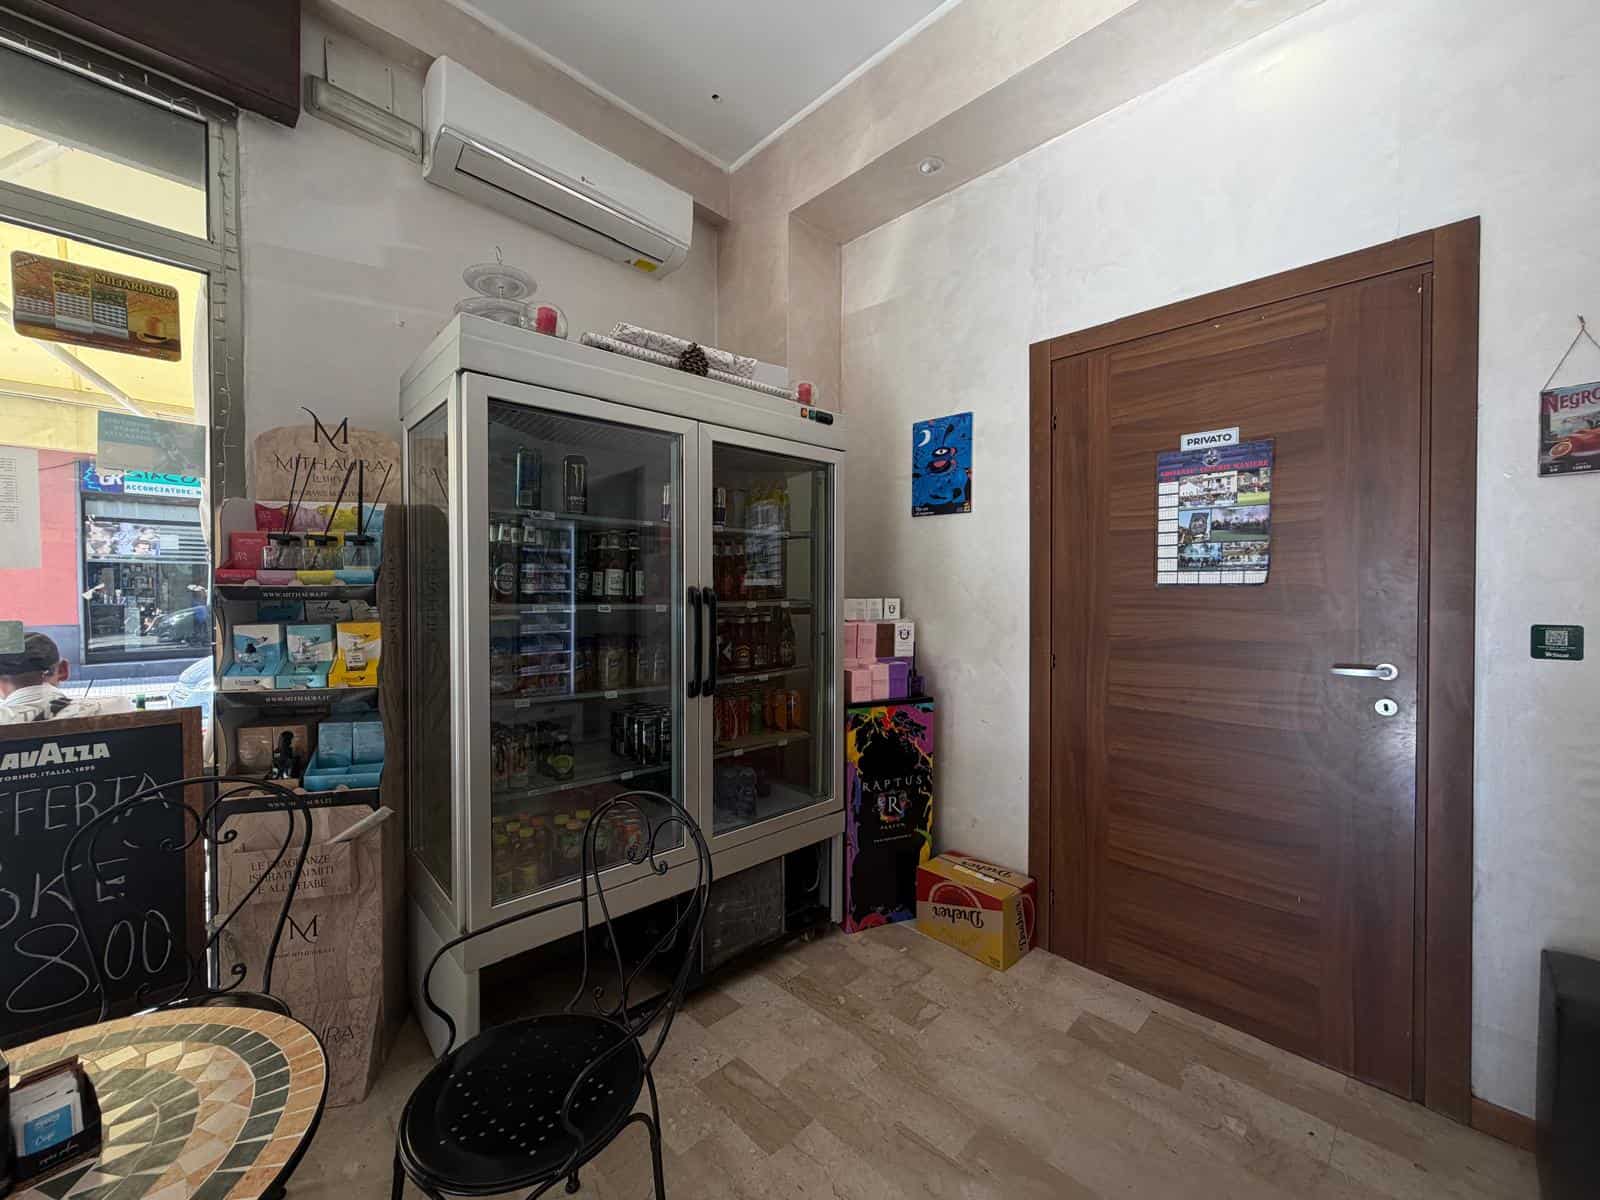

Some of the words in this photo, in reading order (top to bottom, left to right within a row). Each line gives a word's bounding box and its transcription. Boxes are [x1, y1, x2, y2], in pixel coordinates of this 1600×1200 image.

[1187, 433, 1233, 447] PRIVATO
[0, 742, 110, 771] AVAZZA
[862, 775, 923, 792] RAPTUS
[932, 905, 984, 928] Dreher
